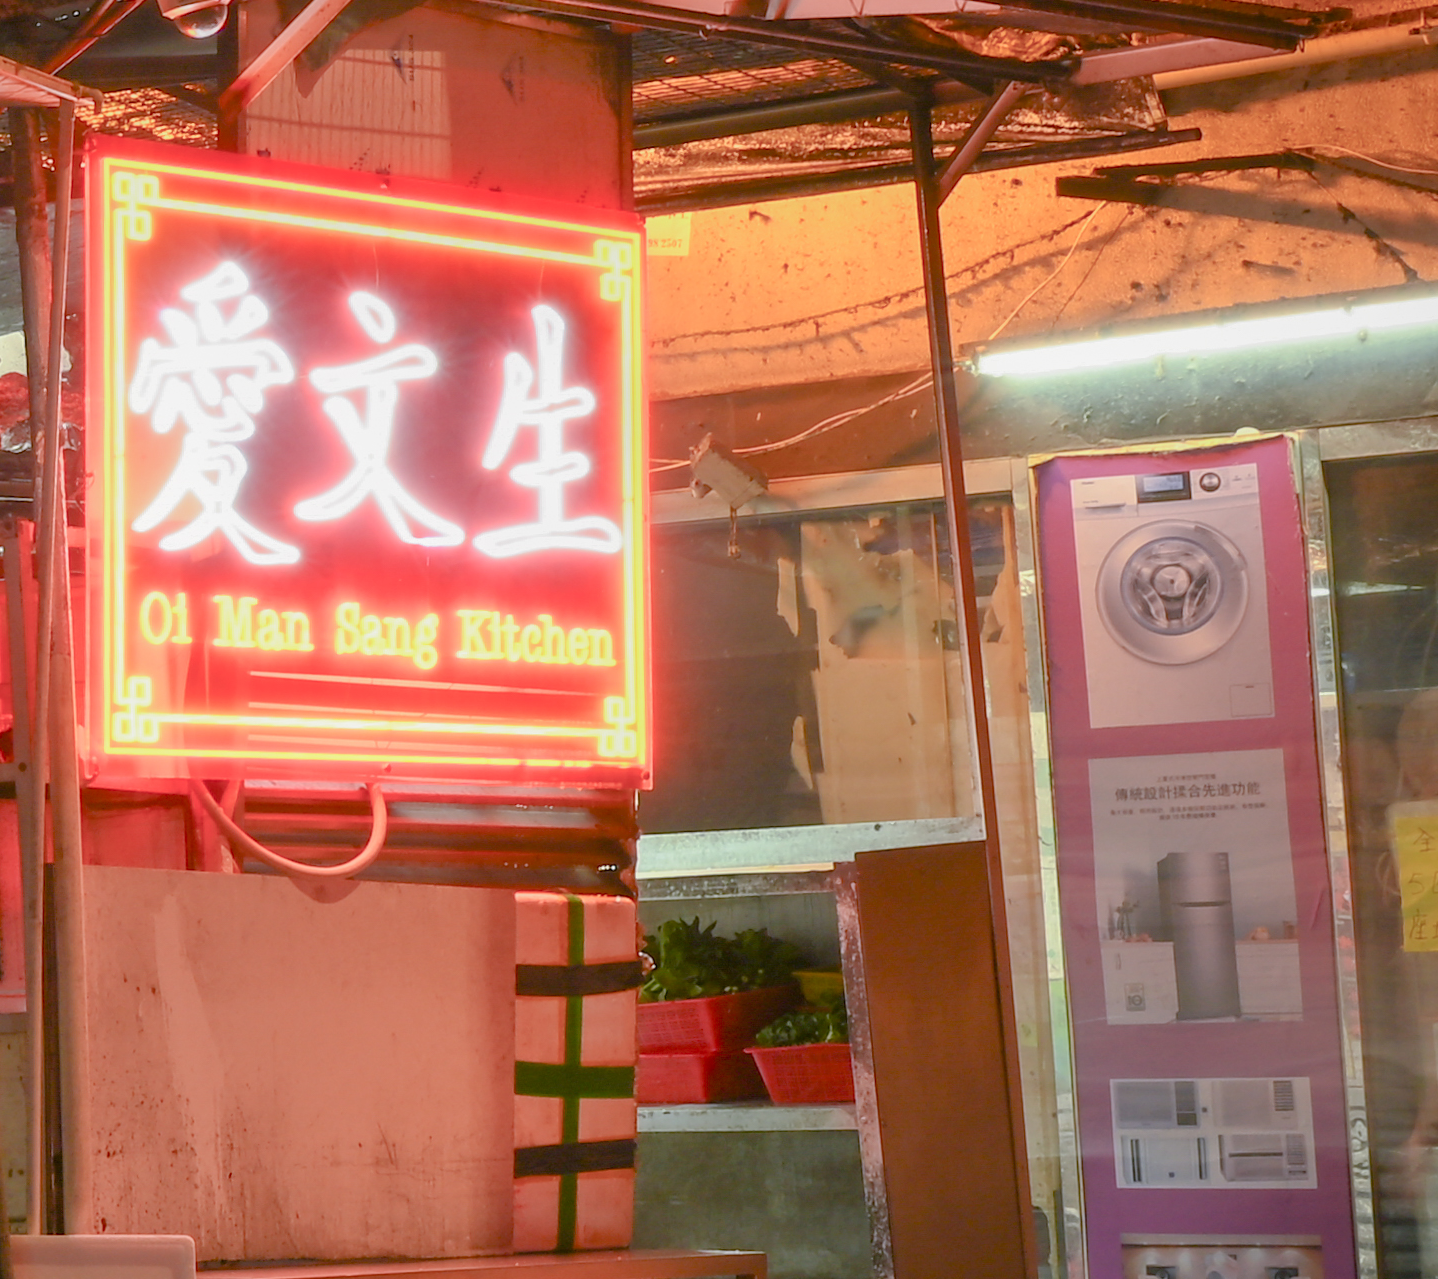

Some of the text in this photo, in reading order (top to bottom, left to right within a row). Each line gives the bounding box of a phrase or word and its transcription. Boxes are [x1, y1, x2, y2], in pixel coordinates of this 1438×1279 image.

[128, 260, 625, 566] 愛文生
[139, 590, 618, 670] Oi Man Sang Kitchen
